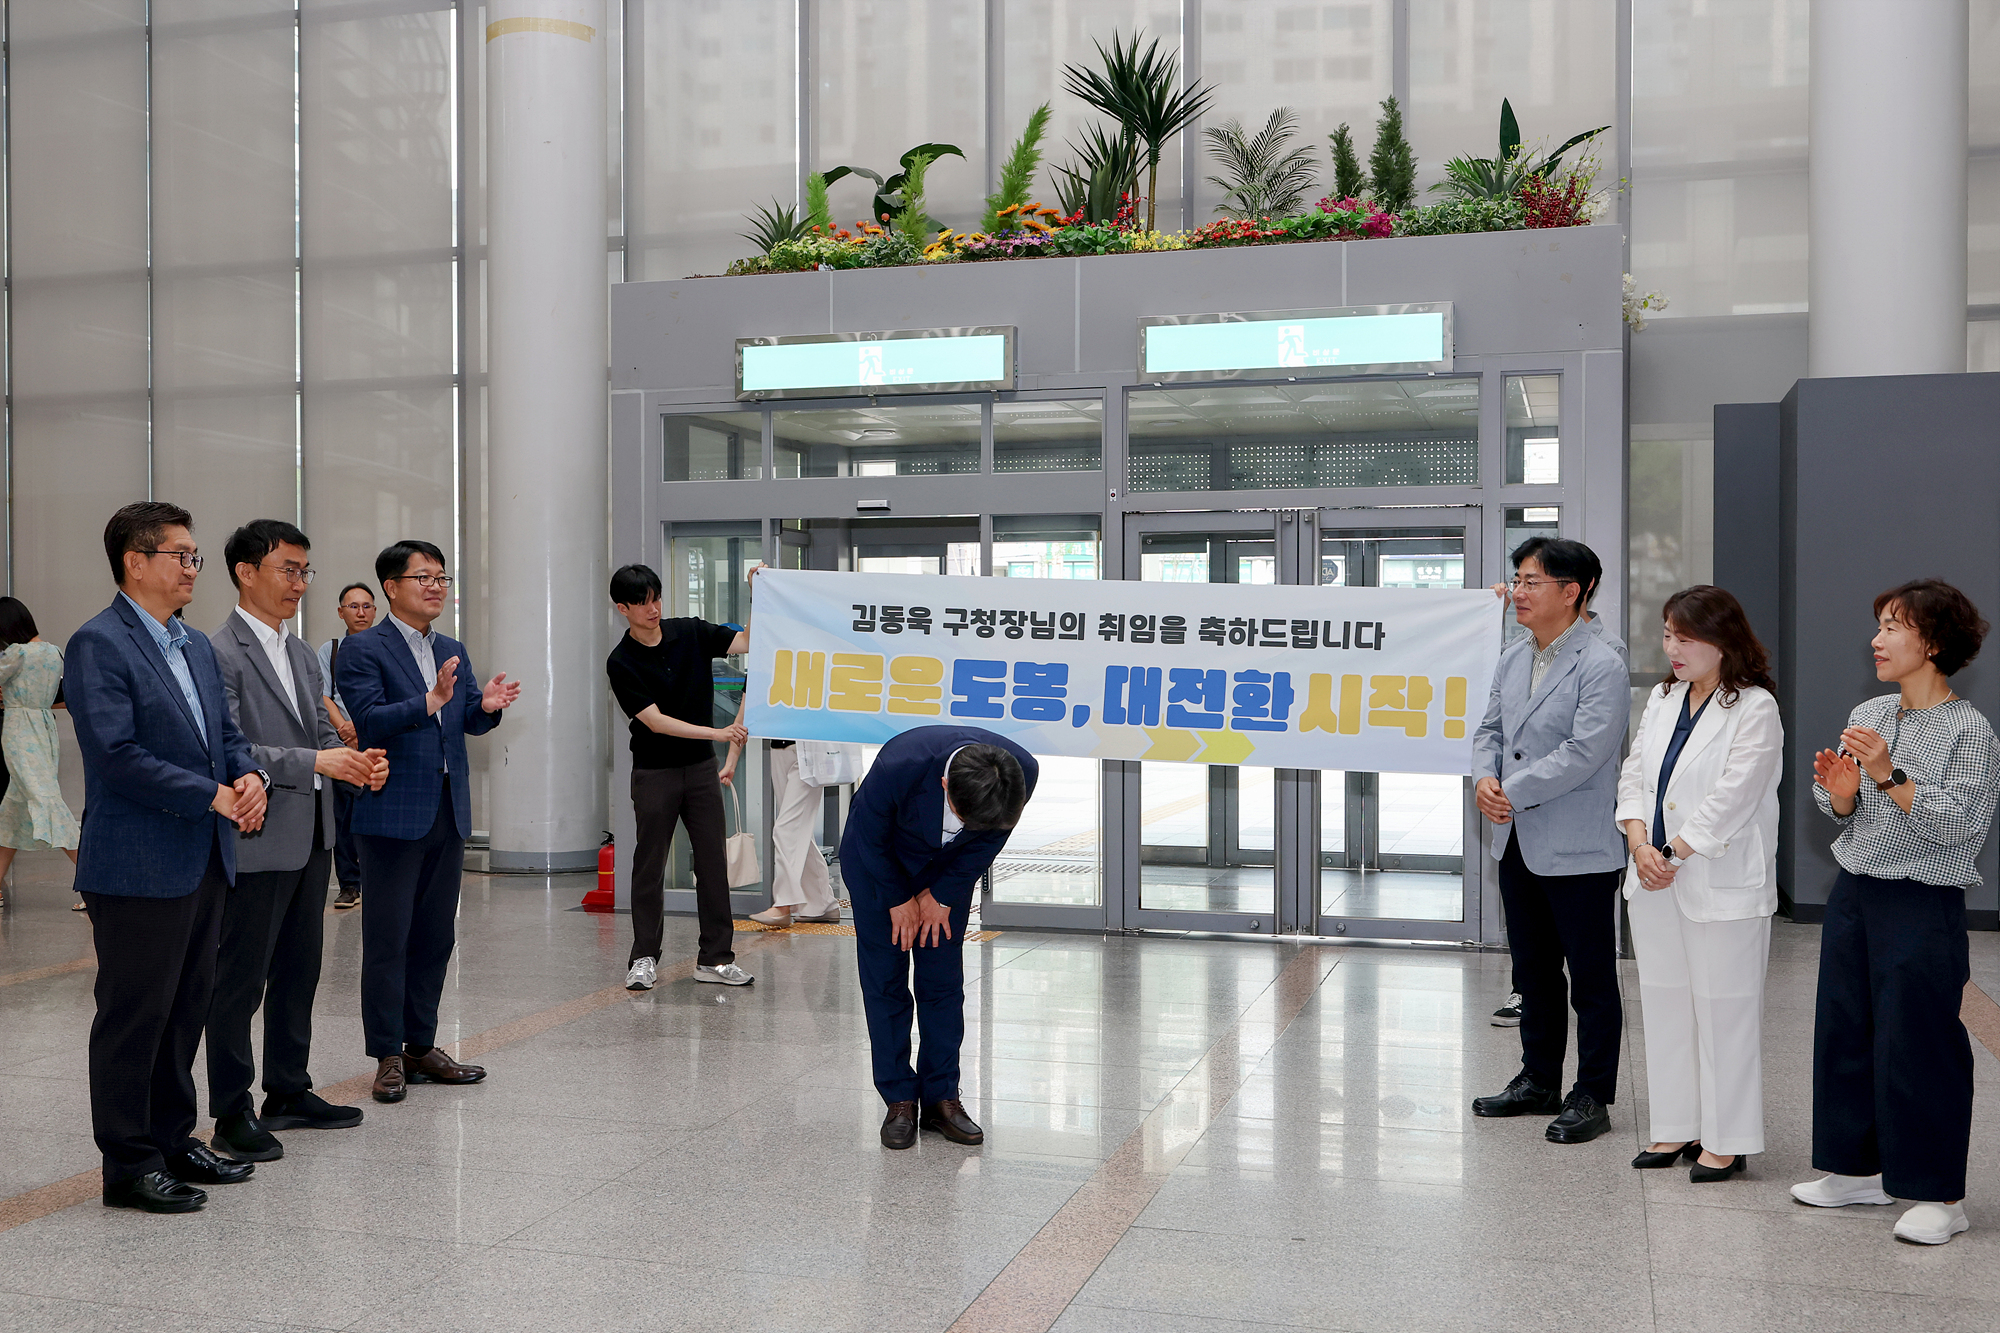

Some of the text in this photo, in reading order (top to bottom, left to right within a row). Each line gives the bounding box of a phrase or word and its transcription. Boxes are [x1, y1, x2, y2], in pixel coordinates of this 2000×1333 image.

[892, 375, 910, 383] EXIT
[852, 604, 1386, 651] 김동욱 구청장님의 취임을 축하드립니다
[769, 649, 1467, 739] 새로운 도봉, 대전환 시작!
